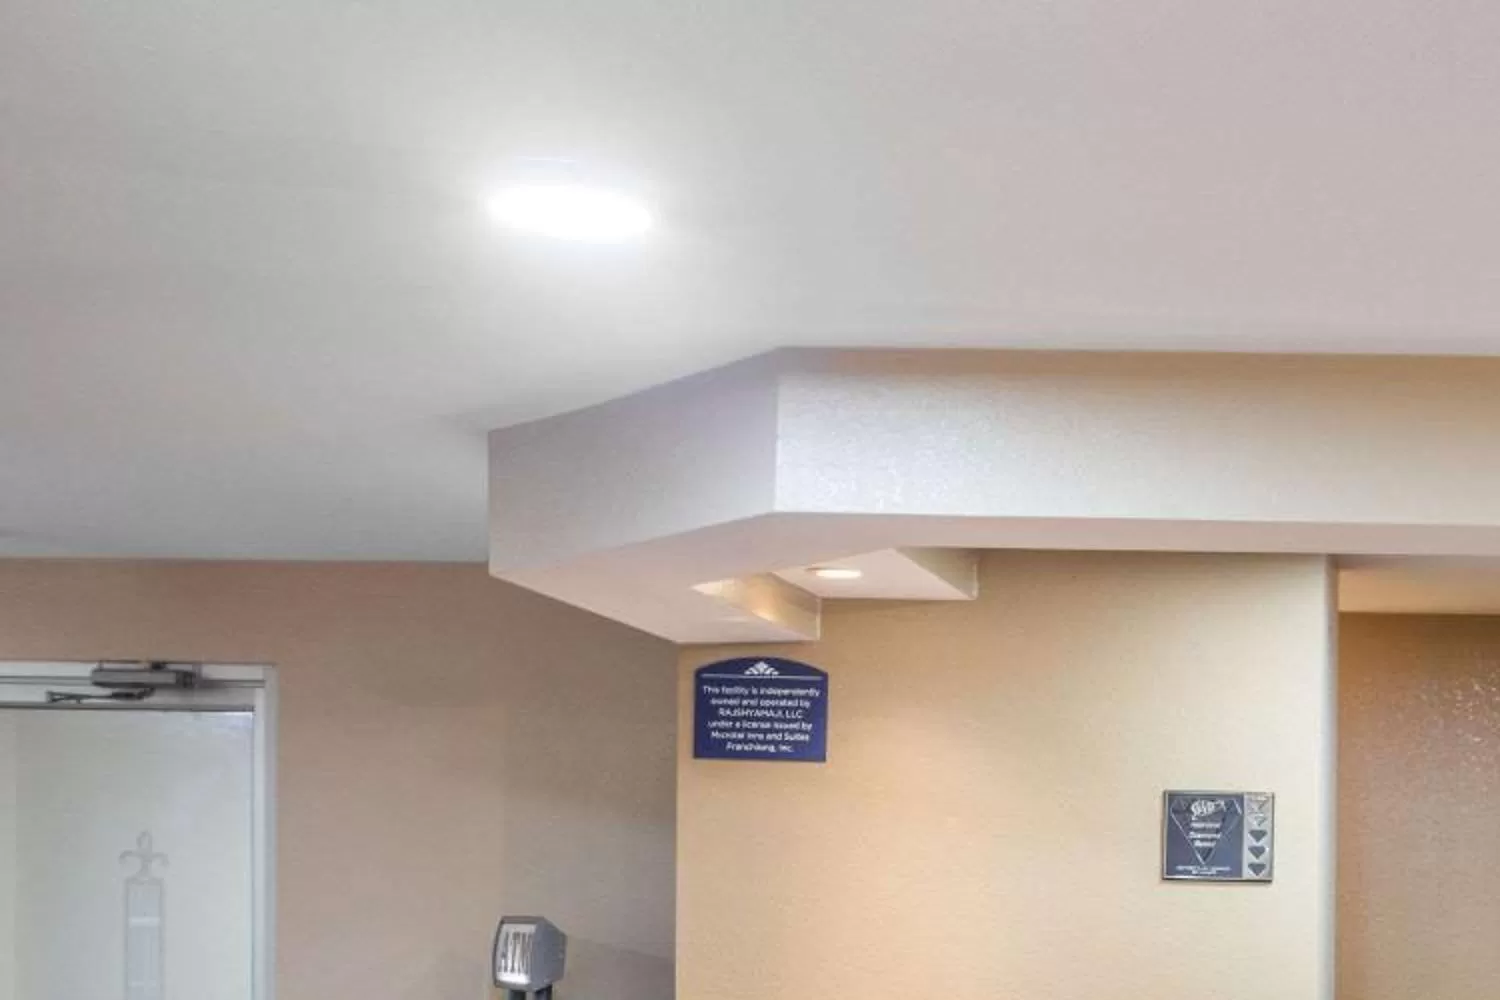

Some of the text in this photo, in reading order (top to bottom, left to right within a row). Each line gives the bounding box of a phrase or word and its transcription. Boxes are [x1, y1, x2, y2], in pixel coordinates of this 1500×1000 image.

[703, 685, 820, 697] This facility is independently
[710, 698, 811, 709] owned and operated by
[786, 709, 804, 719] LLC
[708, 720, 733, 729] under
[742, 720, 771, 729] license
[773, 721, 800, 730] issued
[802, 721, 813, 731] by
[747, 731, 764, 740] Inns
[766, 732, 783, 741] and
[784, 732, 810, 742] Suites
